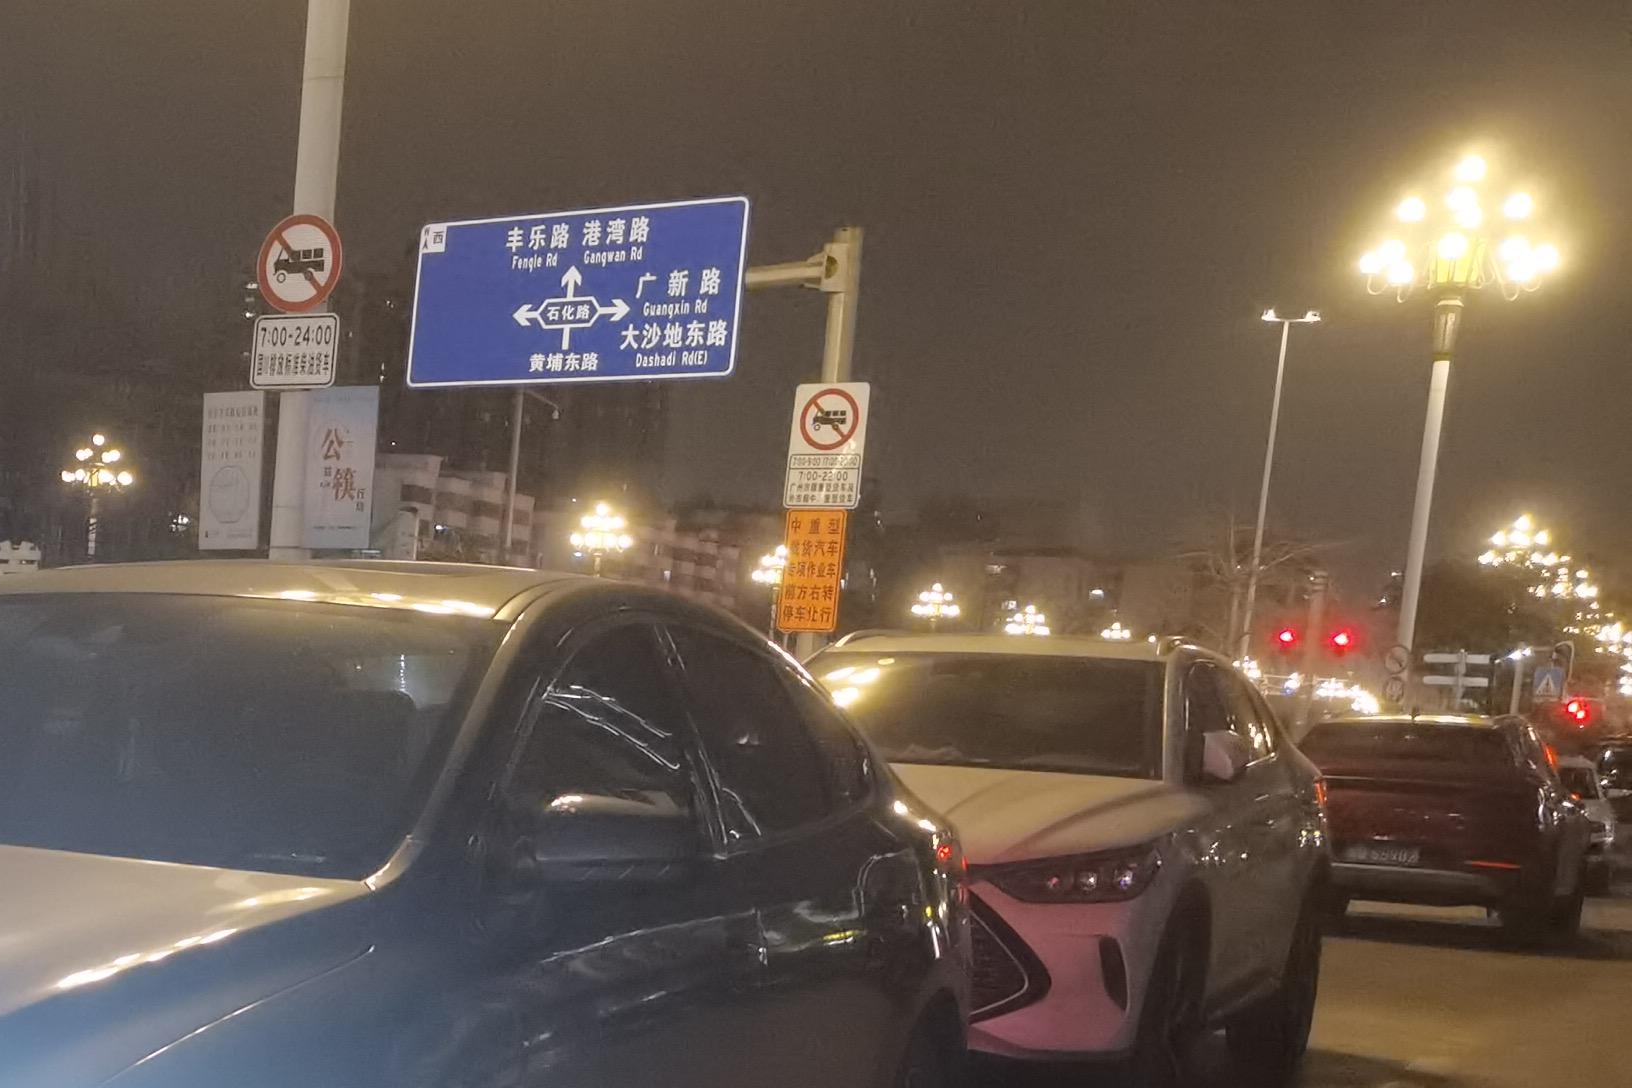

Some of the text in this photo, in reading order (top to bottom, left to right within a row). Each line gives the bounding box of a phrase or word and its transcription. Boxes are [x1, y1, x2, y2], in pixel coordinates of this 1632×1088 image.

[506, 216, 649, 252] 丰乐路 港湾路
[546, 253, 558, 267] Rd
[583, 246, 643, 267] Gangwan Rd
[635, 267, 721, 299] 广新路
[547, 304, 590, 321] 石化路
[643, 299, 708, 318] Guangxin Rd
[261, 325, 332, 347] 7:00-24:00
[619, 320, 728, 350] 大沙地东路
[528, 352, 599, 372] 黄埔东路
[681, 350, 708, 366] Rd(E)
